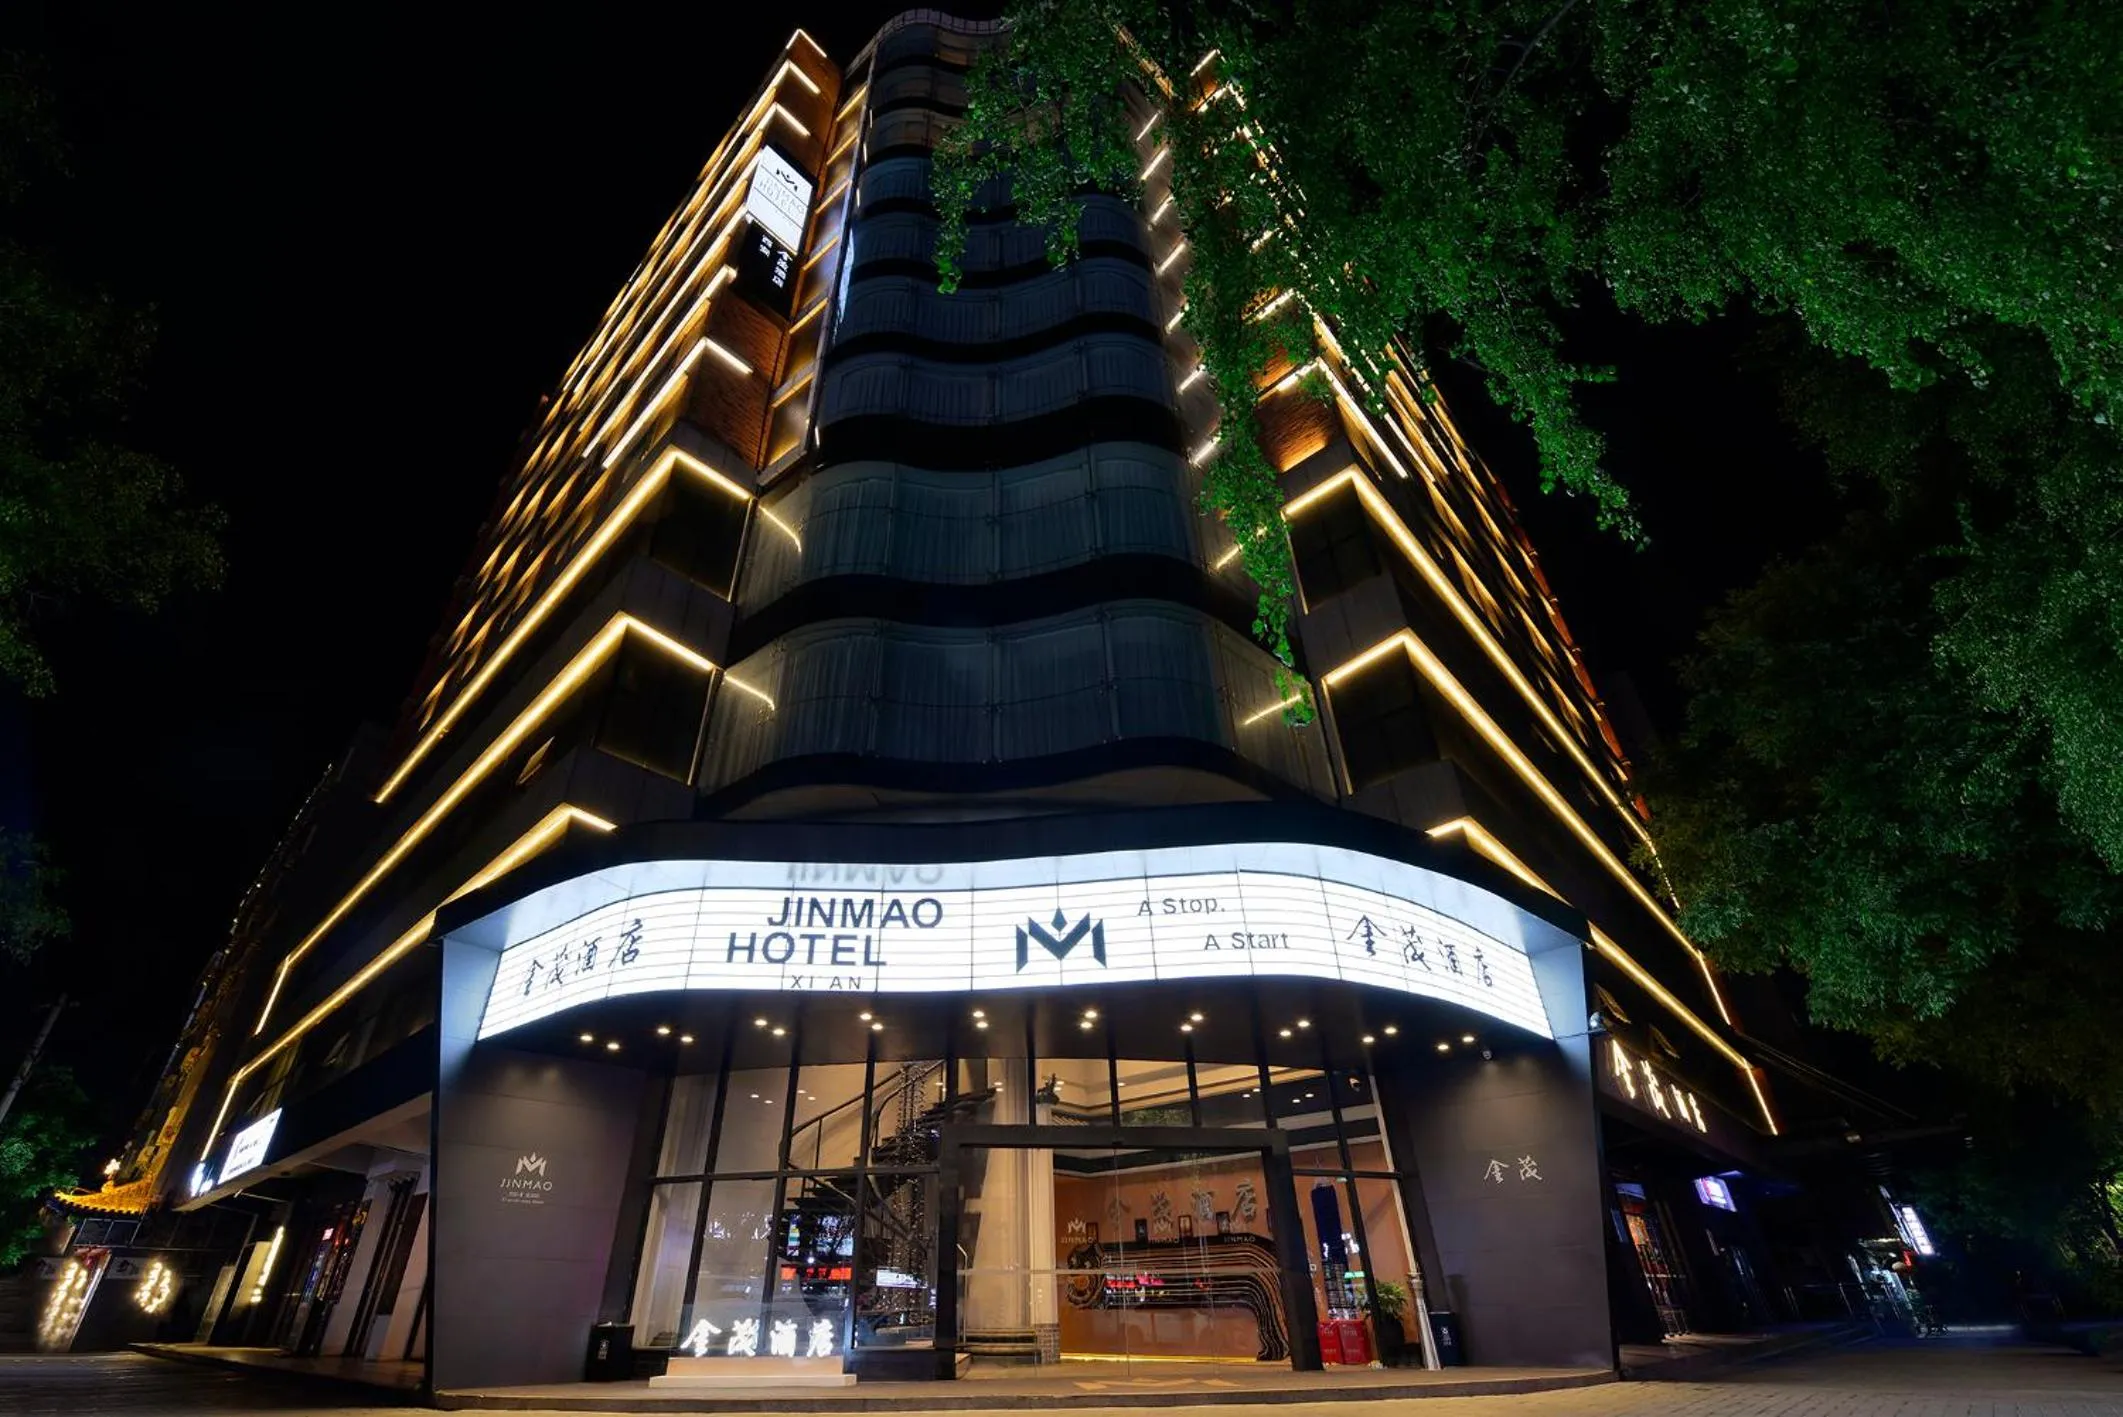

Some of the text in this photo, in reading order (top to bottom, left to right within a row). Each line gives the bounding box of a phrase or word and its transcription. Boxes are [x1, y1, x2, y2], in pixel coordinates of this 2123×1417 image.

[767, 897, 943, 929] JINMAO
[1137, 897, 1226, 916] A Stop.
[726, 932, 887, 966] HOTEL
[1204, 931, 1291, 950] A Start
[1346, 914, 1494, 988] 金茂酒店
[523, 918, 643, 996] 金茂酒店
[499, 1178, 553, 1192] JINMAO
[1483, 1155, 1543, 1184] 金茂
[680, 1318, 834, 1358] 金茂酒店
